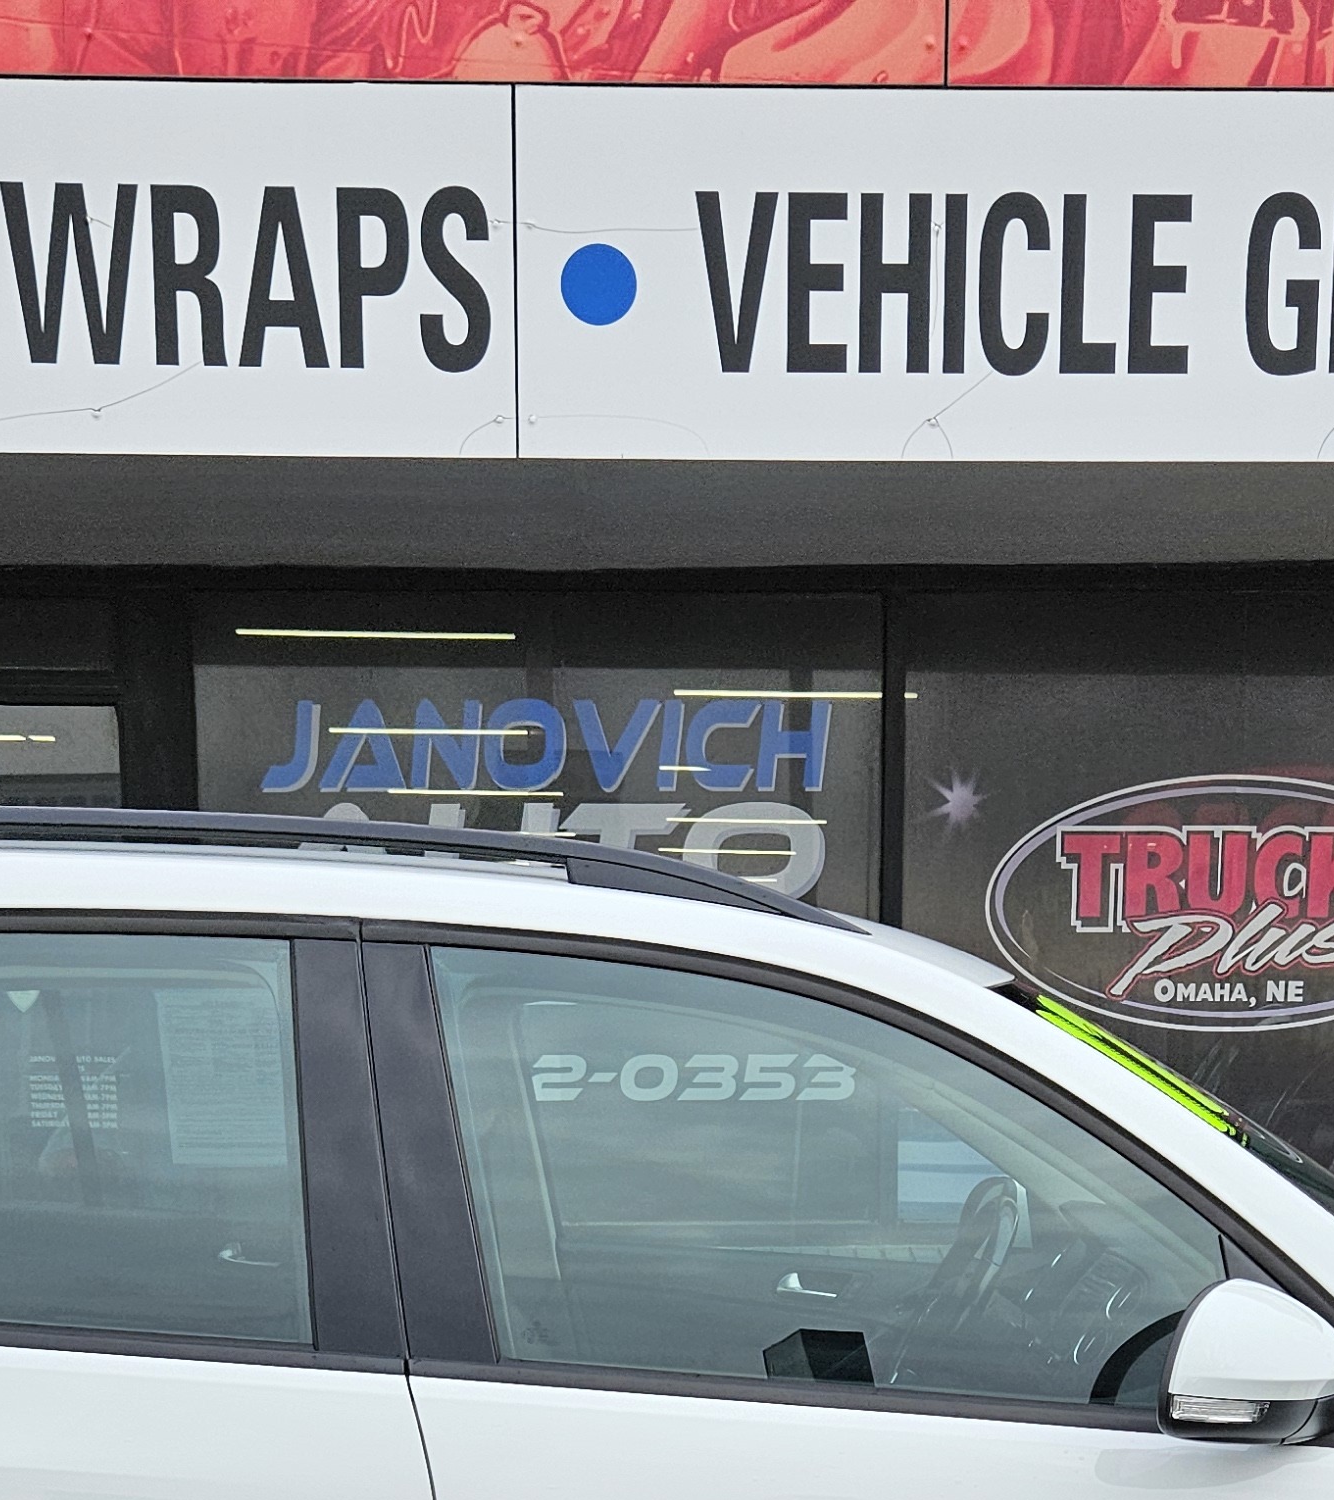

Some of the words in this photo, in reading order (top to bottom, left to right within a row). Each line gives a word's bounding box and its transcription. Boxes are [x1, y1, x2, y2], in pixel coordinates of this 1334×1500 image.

[0, 182, 492, 373] WRAPS
[696, 191, 1193, 376] VEHICLE
[261, 698, 833, 793] JANOVICH
[1265, 979, 1304, 1003] NE
[531, 1053, 856, 1101] 2-0353
